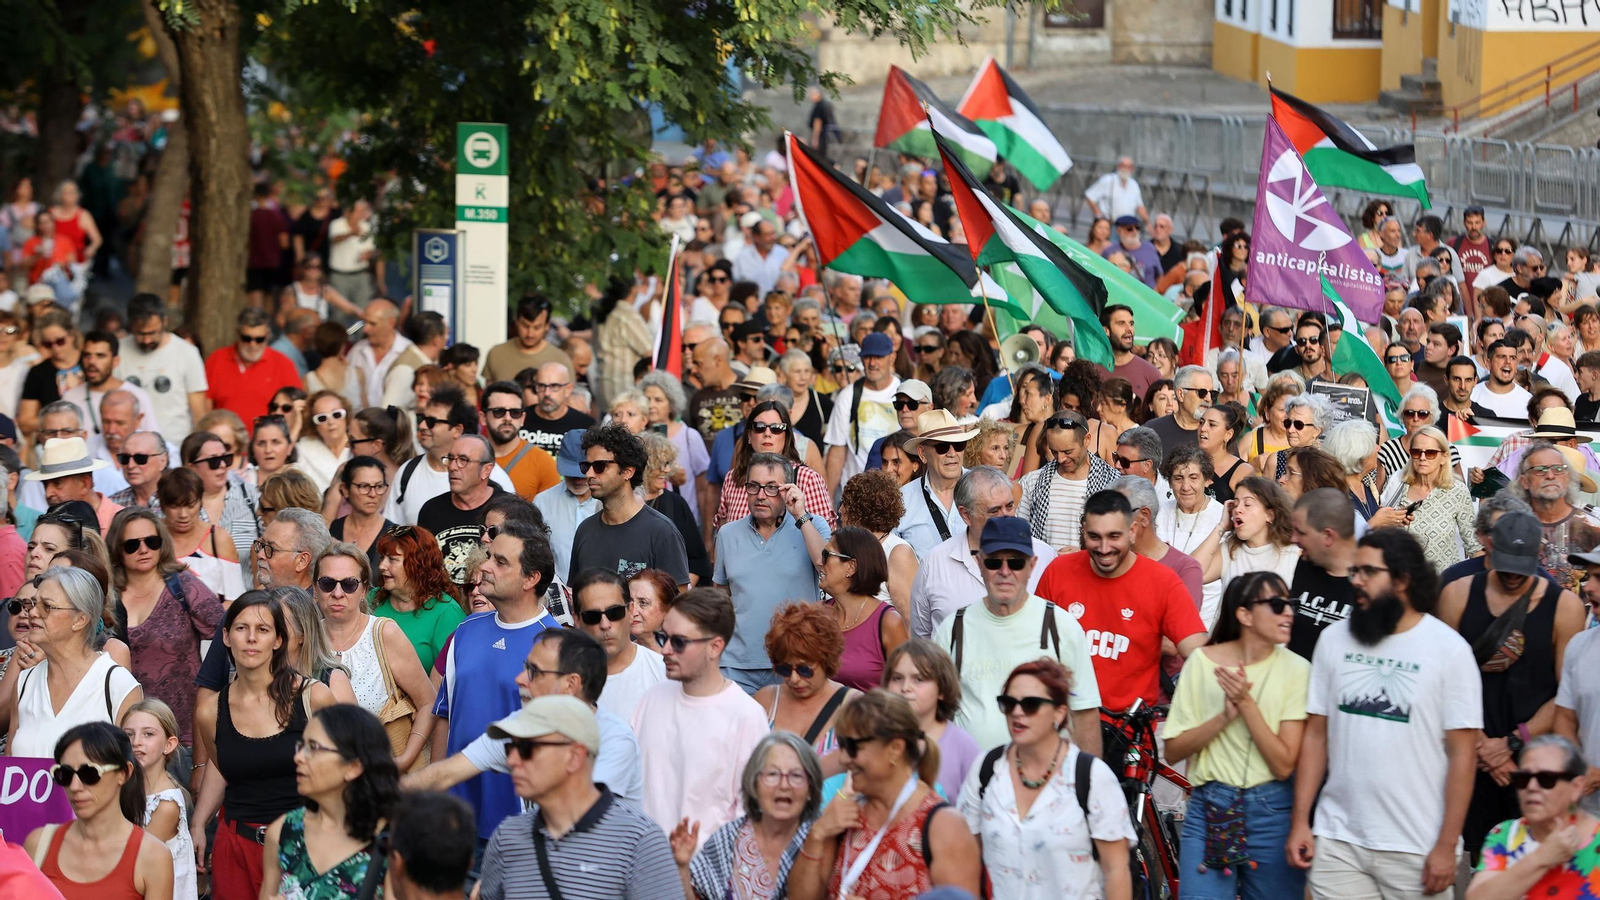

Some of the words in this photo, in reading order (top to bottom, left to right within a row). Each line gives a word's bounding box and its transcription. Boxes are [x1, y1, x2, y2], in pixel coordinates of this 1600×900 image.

[475, 187, 487, 200] K
[1256, 251, 1382, 287] anticapitalistas
[1344, 652, 1421, 672] MOUNTAIN
